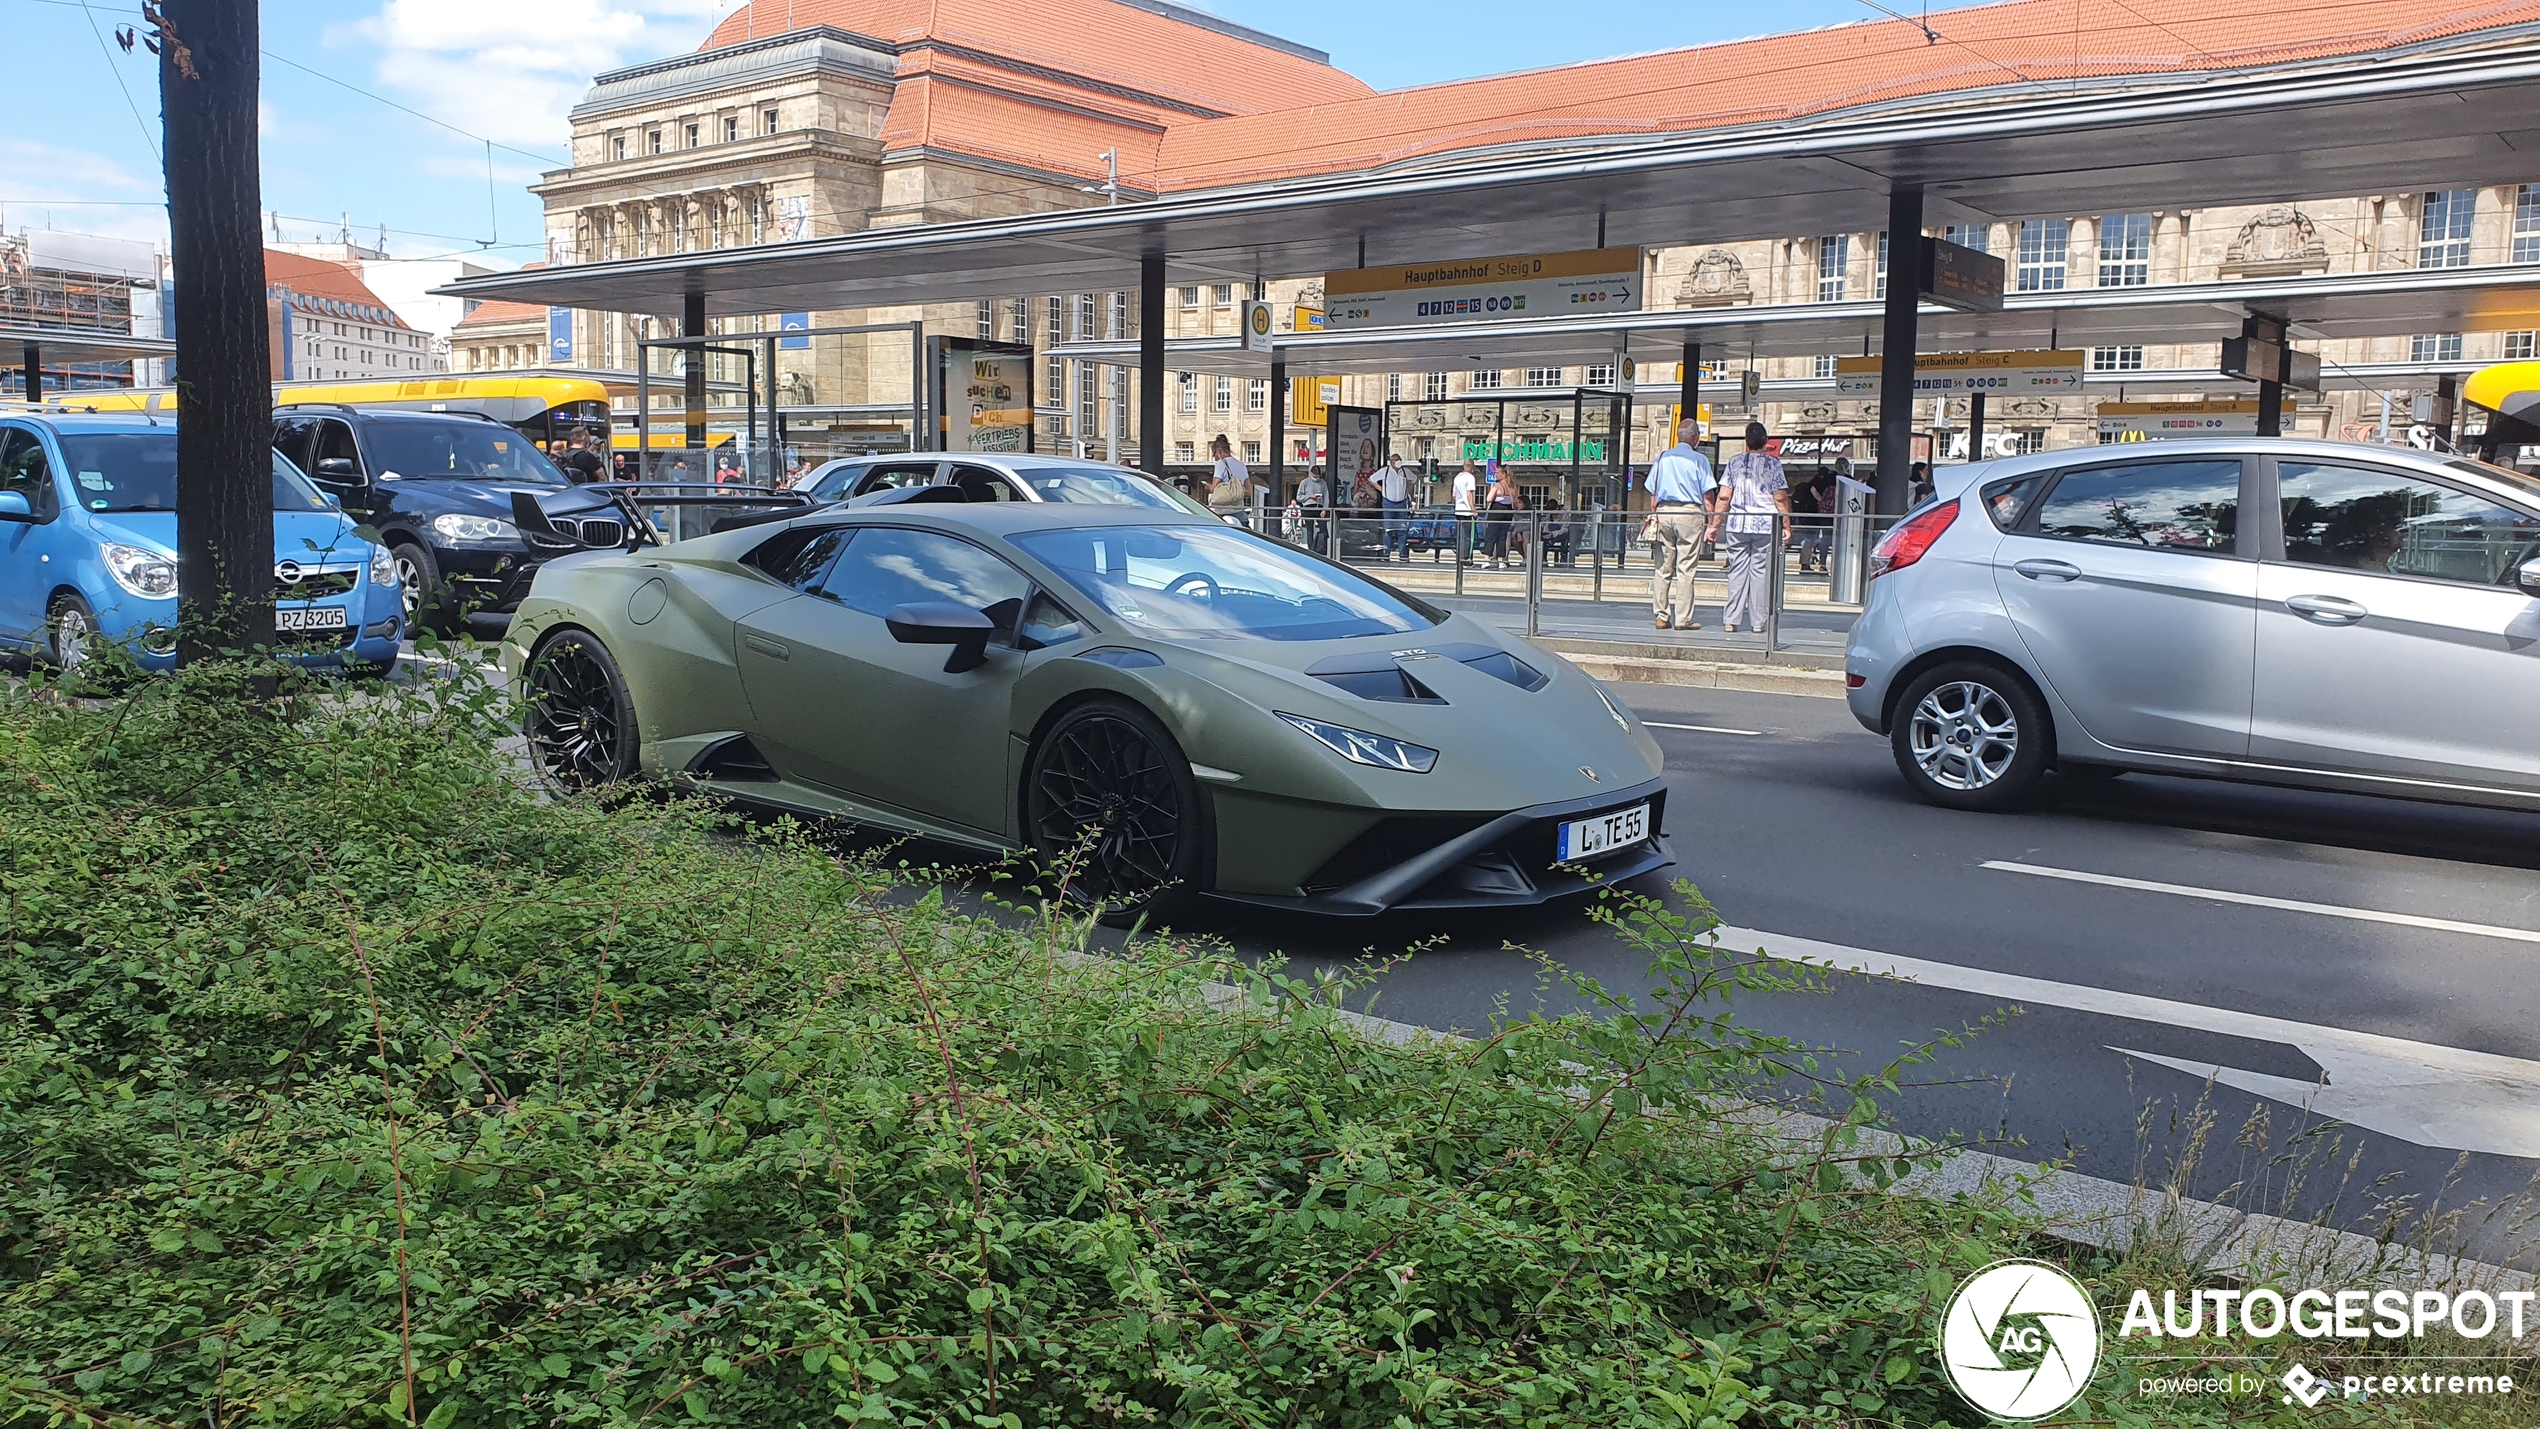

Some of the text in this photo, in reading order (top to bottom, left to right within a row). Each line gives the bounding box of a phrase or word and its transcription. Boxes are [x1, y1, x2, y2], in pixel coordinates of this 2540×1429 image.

[1405, 259, 1542, 284] Hauptbahnhof Steig D
[1420, 304, 1426, 314] 4
[1434, 303, 1439, 313] 7
[1444, 303, 1453, 313] 12
[1470, 300, 1480, 310] 15
[1501, 298, 1511, 308] N9
[1257, 309, 1265, 328] H
[975, 360, 1000, 377] Wir
[1976, 357, 1999, 368] Steig
[2003, 355, 2009, 364] C
[1463, 442, 1603, 460] DEICHMANN
[1781, 438, 1851, 454] Pizza Hut
[1948, 433, 2023, 456] KFC
[281, 610, 343, 628] PZ 3205
[1582, 810, 1642, 852] L TE 55
[1560, 846, 1566, 855] D
